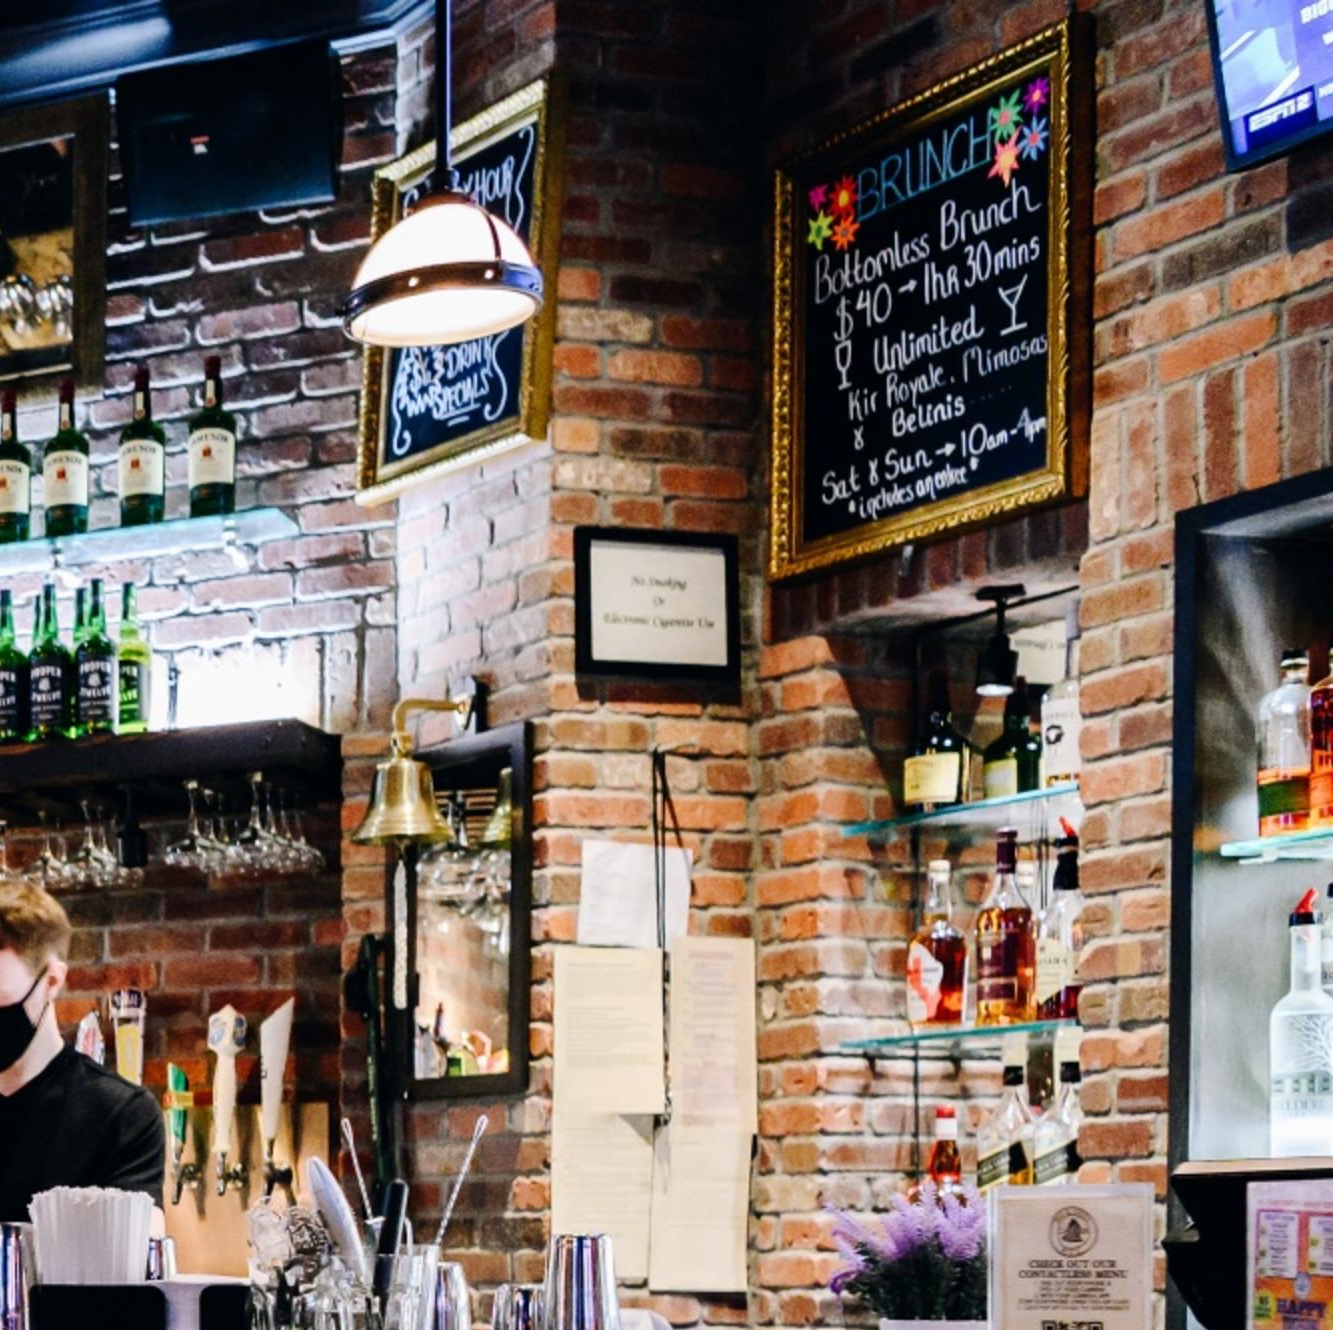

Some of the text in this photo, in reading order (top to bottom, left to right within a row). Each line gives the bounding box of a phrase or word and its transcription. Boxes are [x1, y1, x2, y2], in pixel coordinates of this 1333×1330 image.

[856, 107, 995, 221] BRUNCH
[815, 178, 1041, 304] Bottomless Brunch
[834, 283, 893, 342] $40
[873, 304, 985, 375] Unlimited
[848, 389, 878, 421] Kir
[962, 333, 1048, 384] Mimosas
[821, 464, 861, 505] Sat
[884, 447, 933, 481] Sun
[1018, 1269, 1130, 1279] CONTACTLESS MENU
[1028, 1259, 1117, 1269] CHECK OUT OUR
